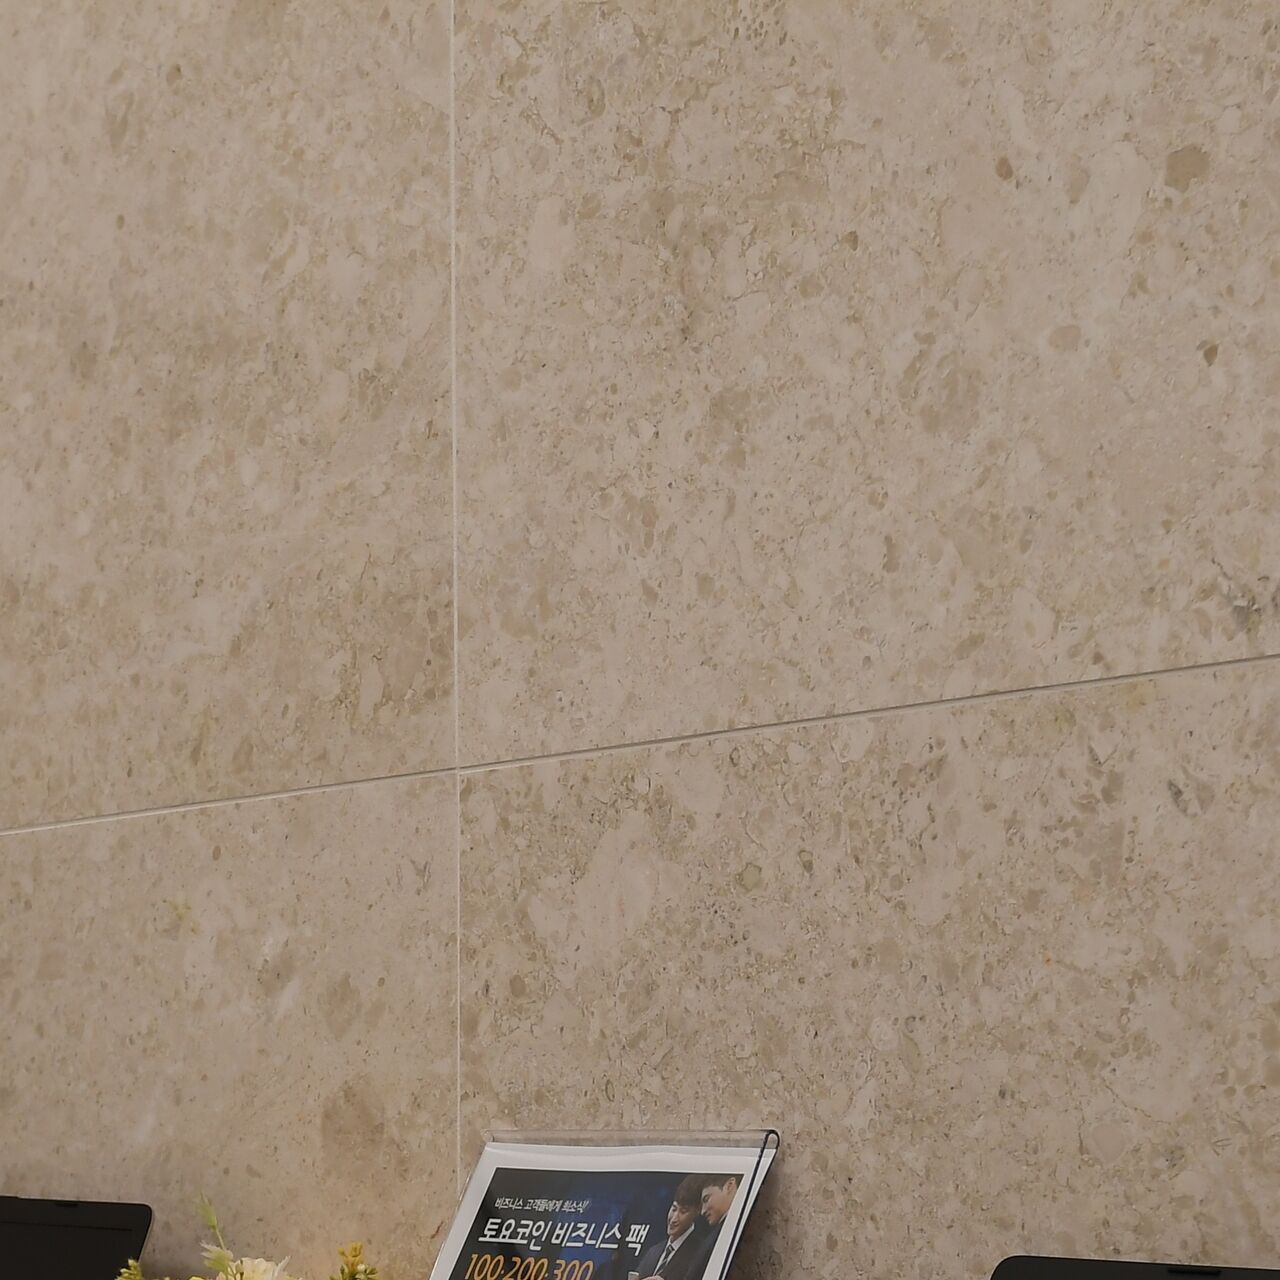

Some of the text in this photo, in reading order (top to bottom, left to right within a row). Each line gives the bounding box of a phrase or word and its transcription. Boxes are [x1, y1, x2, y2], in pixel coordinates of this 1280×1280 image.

[494, 1197, 523, 1210] 비즈니스
[478, 1218, 650, 1256] 토요코인 비즈니스 팩
